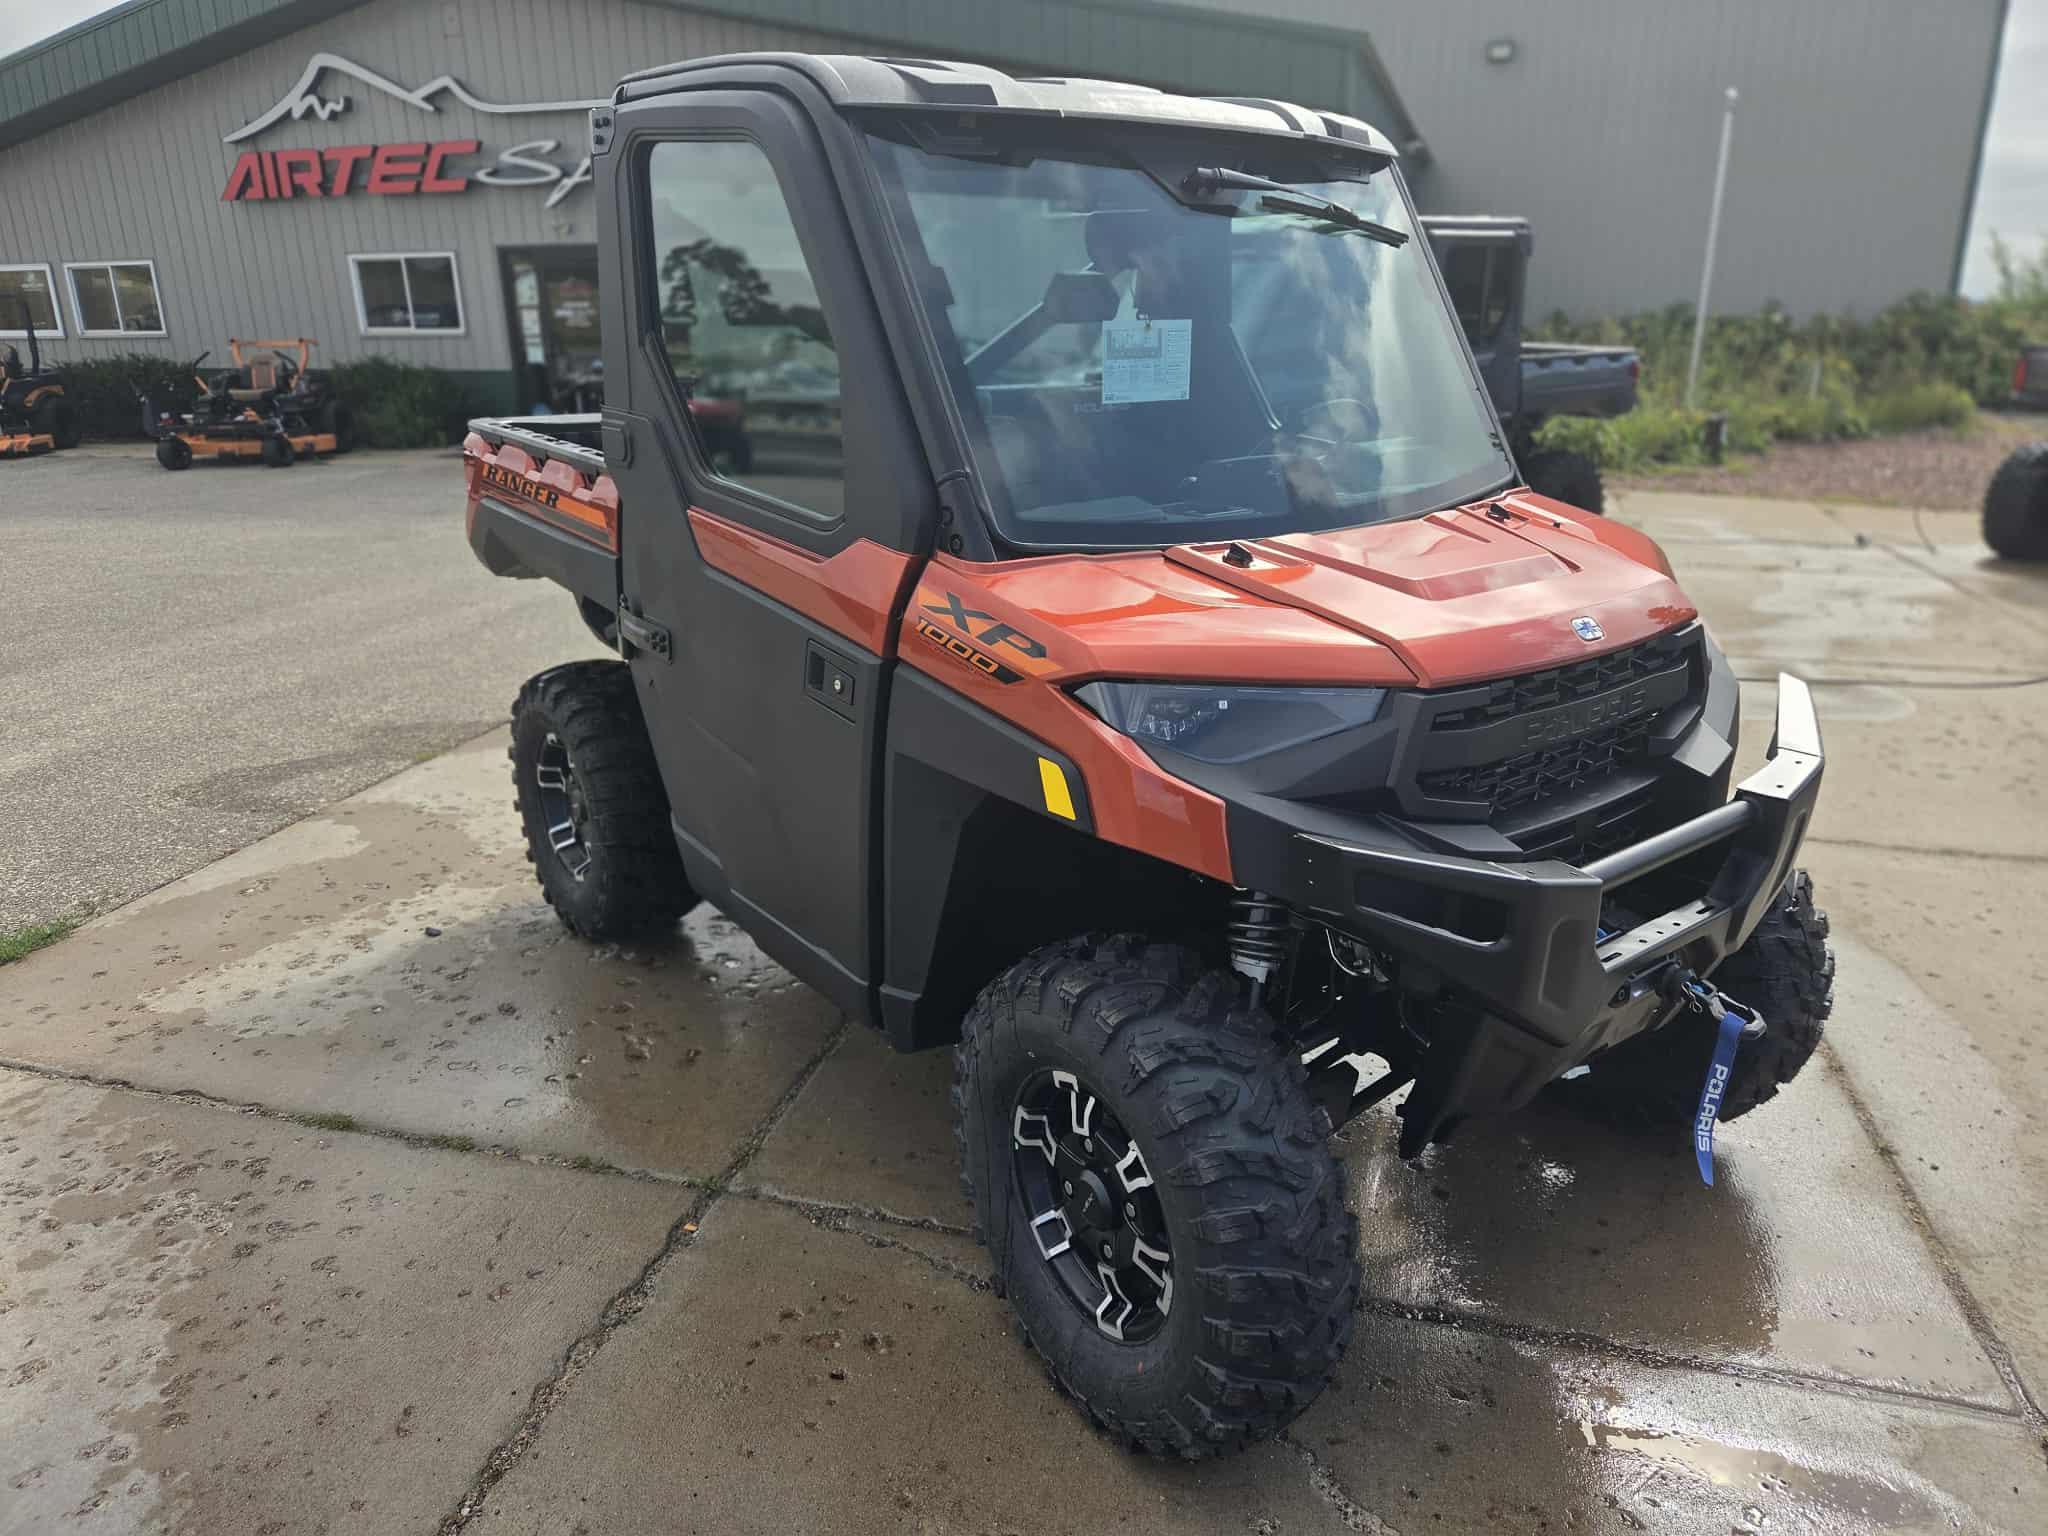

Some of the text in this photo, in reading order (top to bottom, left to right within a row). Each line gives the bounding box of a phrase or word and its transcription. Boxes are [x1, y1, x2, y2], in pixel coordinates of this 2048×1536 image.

[222, 140, 478, 201] AIRTEC
[485, 464, 560, 508] RANGER
[915, 618, 999, 674] 1000
[921, 591, 1047, 658] XP
[1697, 1063, 1728, 1152] POLARIS
